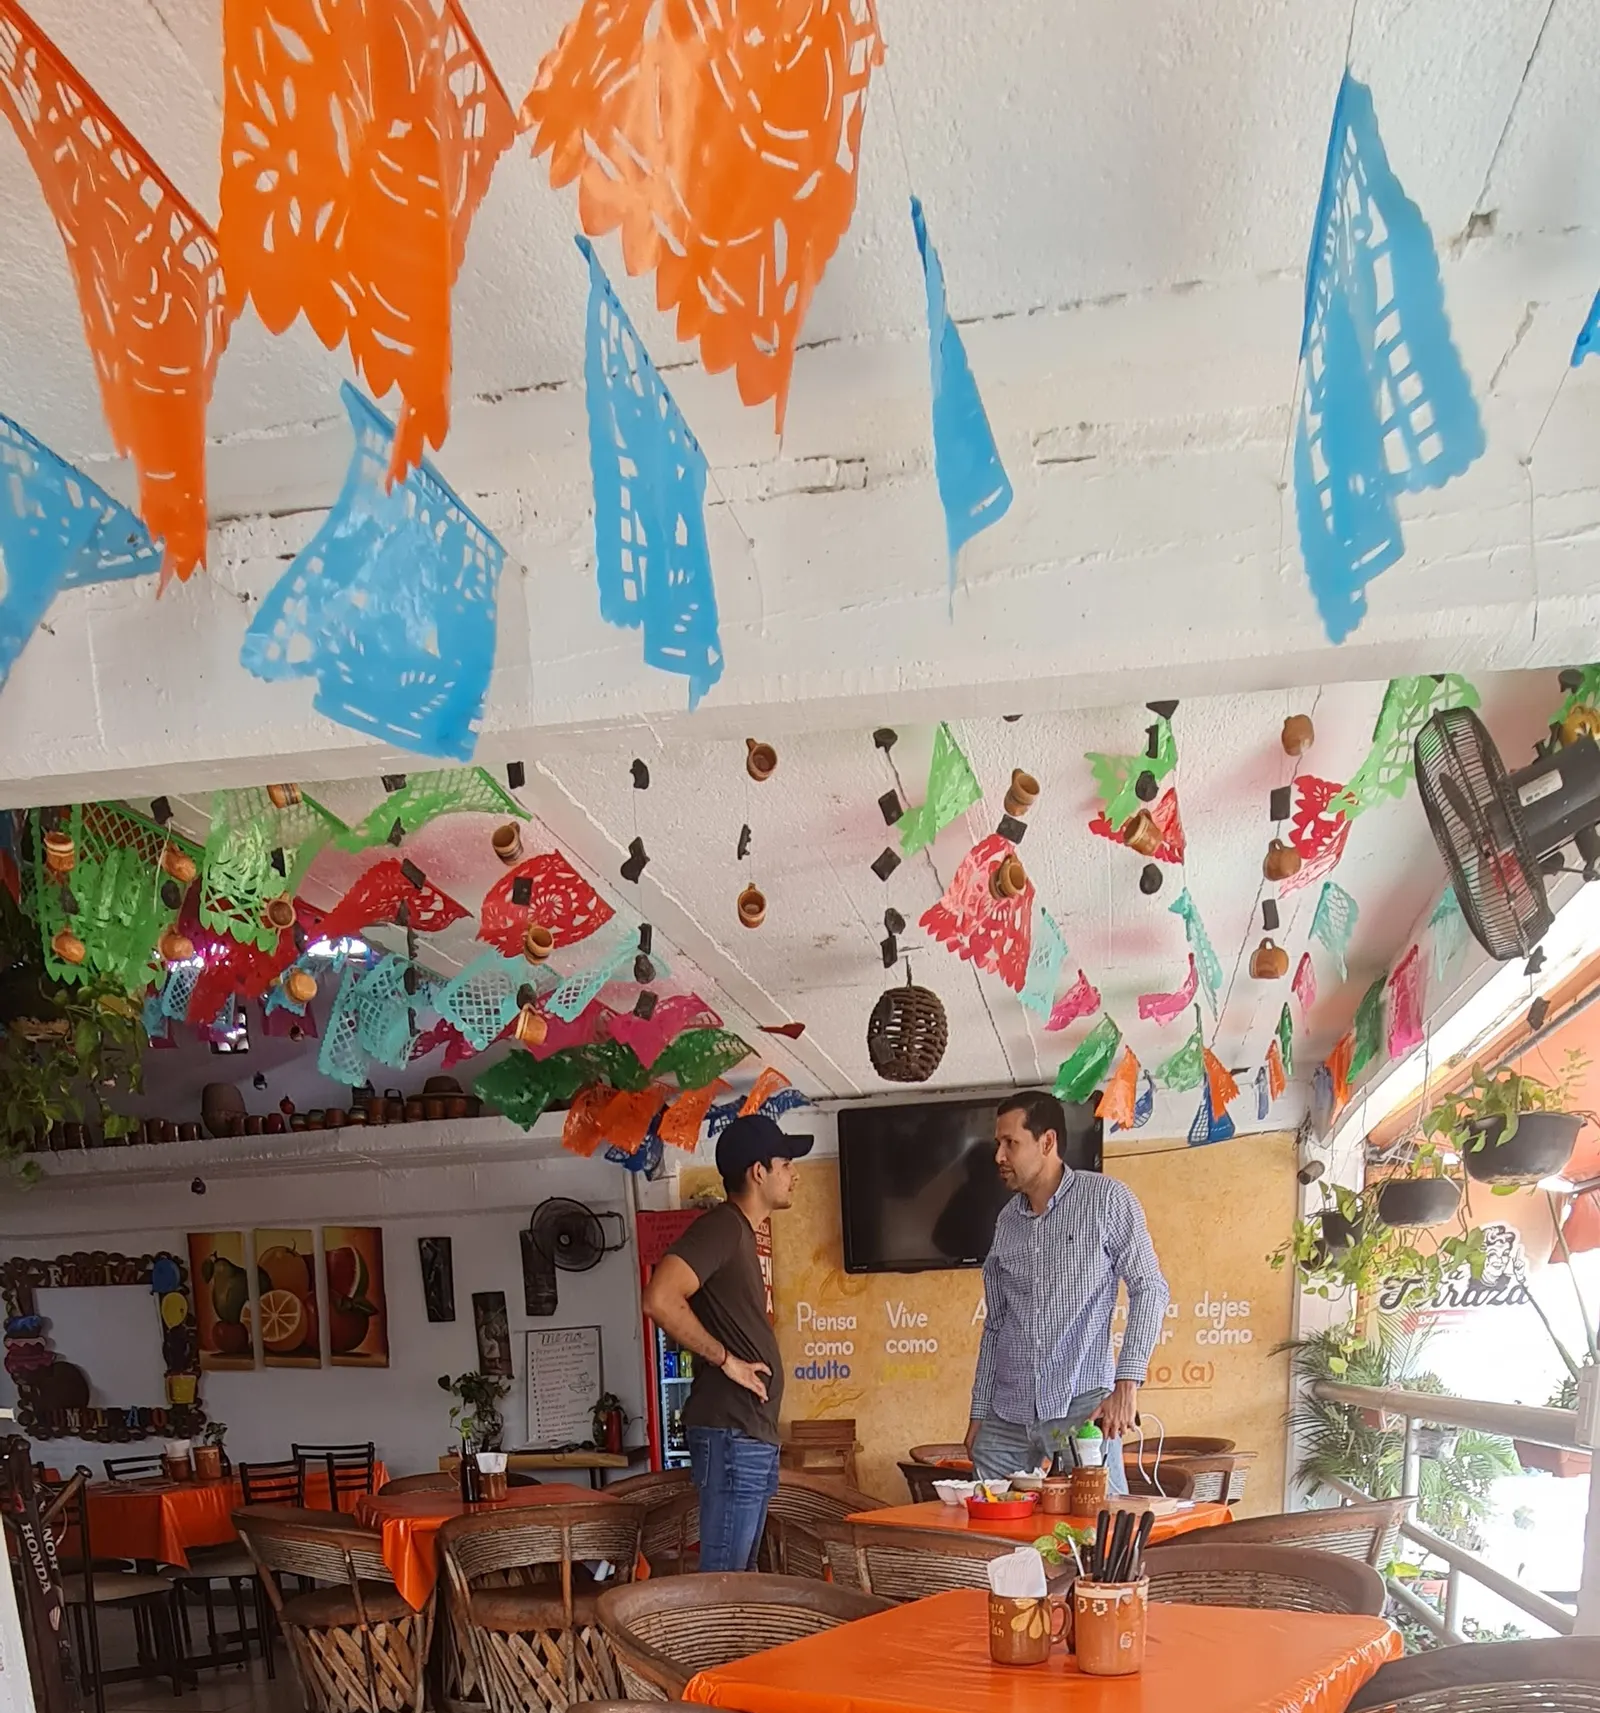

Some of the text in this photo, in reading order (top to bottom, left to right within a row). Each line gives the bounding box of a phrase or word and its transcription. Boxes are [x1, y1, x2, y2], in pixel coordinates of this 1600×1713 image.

[1380, 1276, 1531, 1310] Trraza
[796, 1301, 857, 1332] Piensa
[885, 1300, 929, 1329] Vive
[1194, 1290, 1251, 1329] dejes
[804, 1340, 855, 1356] como
[885, 1337, 939, 1354] como
[1195, 1328, 1253, 1346] como
[794, 1360, 851, 1381] adulto
[1181, 1359, 1215, 1384] (a)
[21, 1522, 51, 1596] HONDA
[43, 1525, 59, 1572] HON
